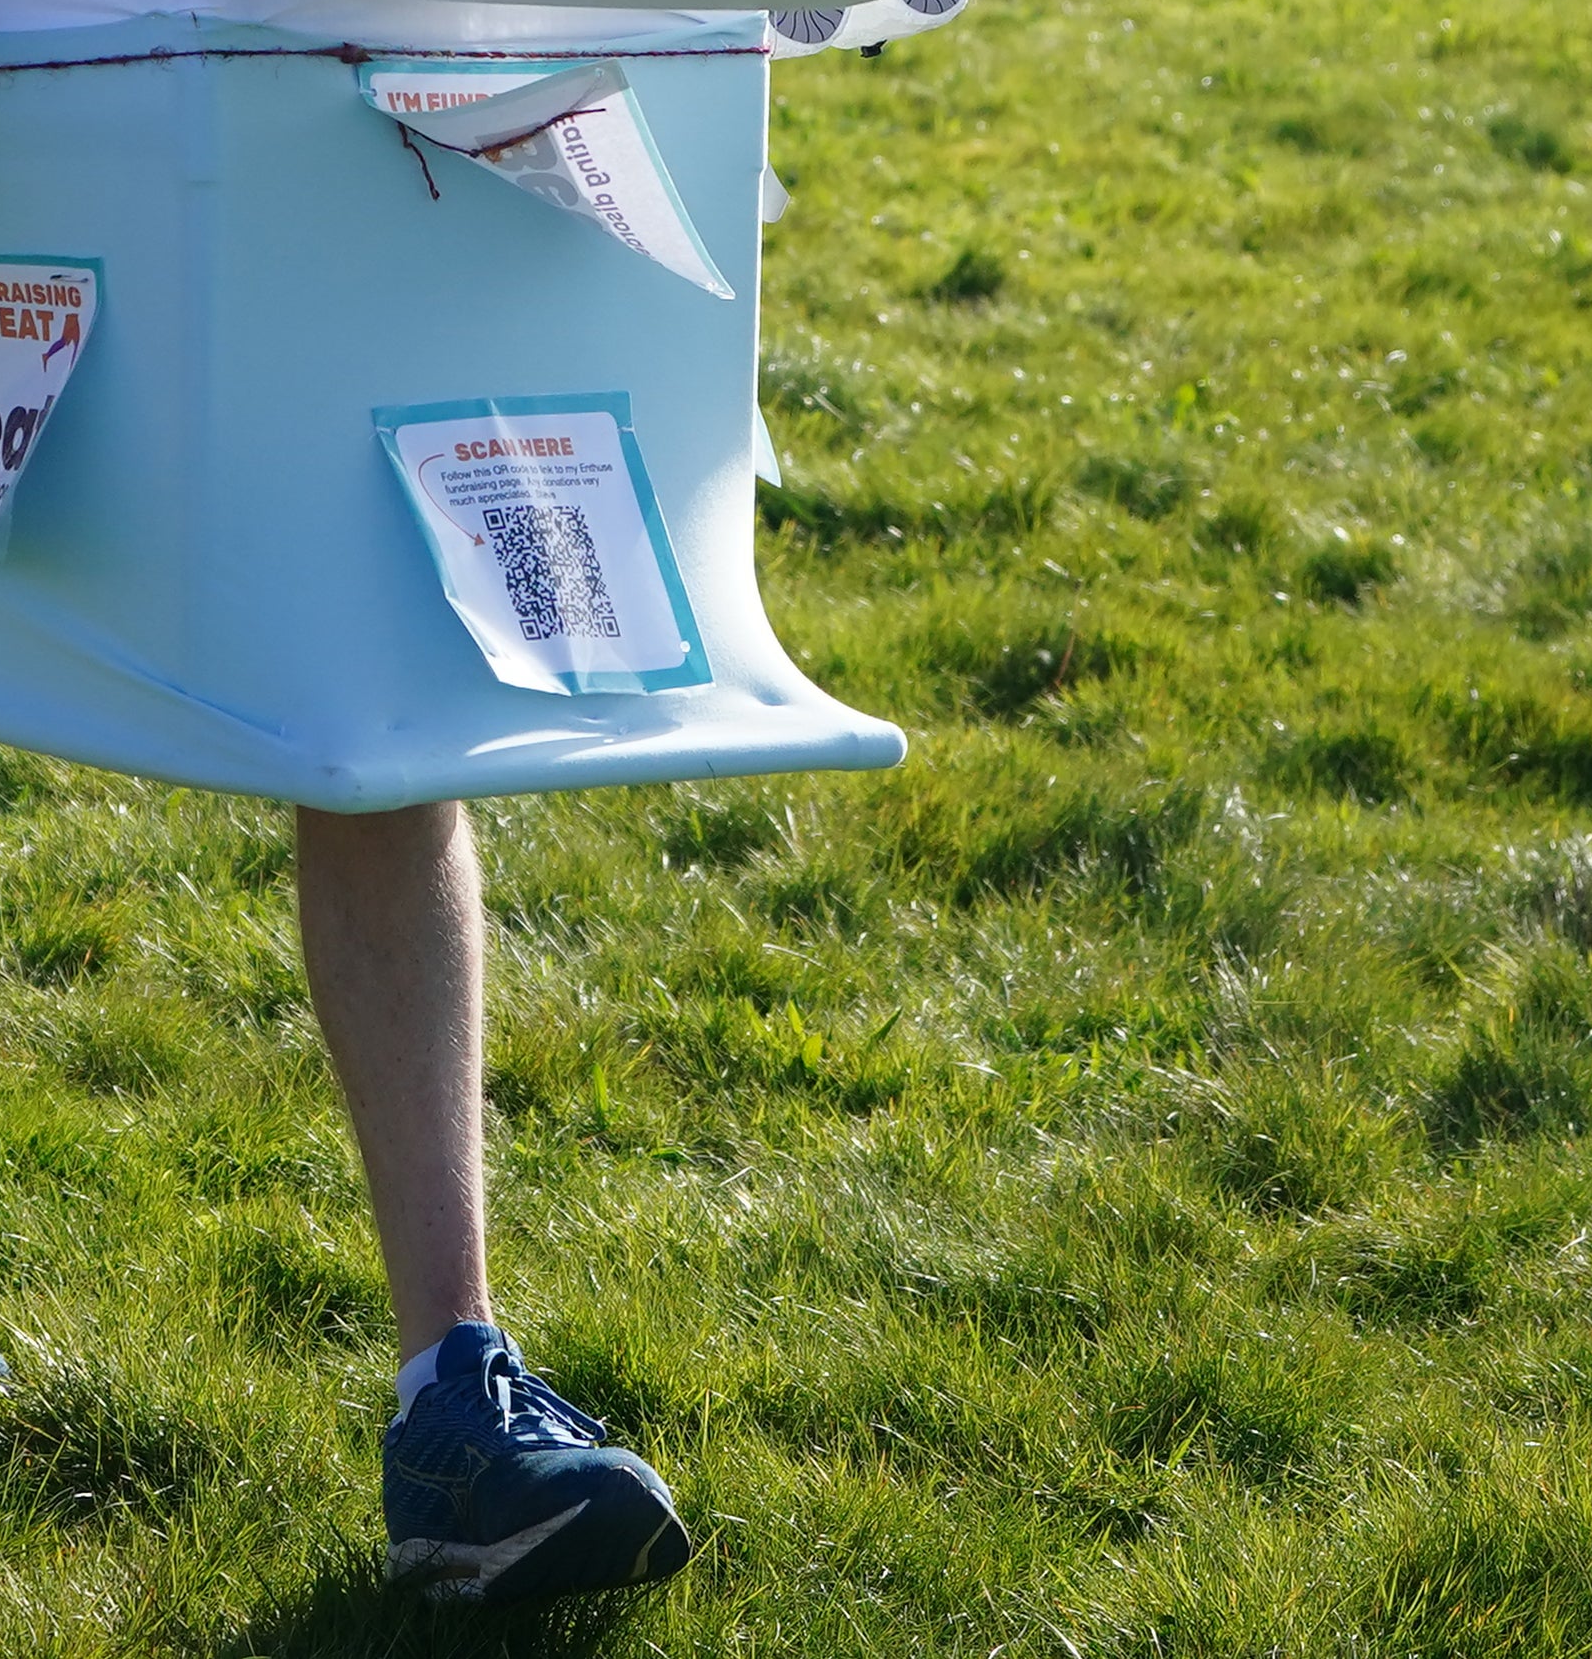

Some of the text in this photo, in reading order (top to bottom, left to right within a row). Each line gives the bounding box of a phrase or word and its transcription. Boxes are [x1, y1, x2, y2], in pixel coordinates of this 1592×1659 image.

[387, 92, 423, 112] I'M
[454, 437, 574, 462] SCAN HERE
[440, 470, 472, 482] Follow
[473, 467, 492, 478] this
[492, 464, 509, 475] QR
[554, 465, 564, 474] to
[565, 465, 578, 476] my
[579, 462, 613, 473] Enthuse
[444, 480, 498, 495] fundraising
[541, 476, 581, 487] donations
[581, 477, 599, 487] very
[449, 495, 476, 507] much
